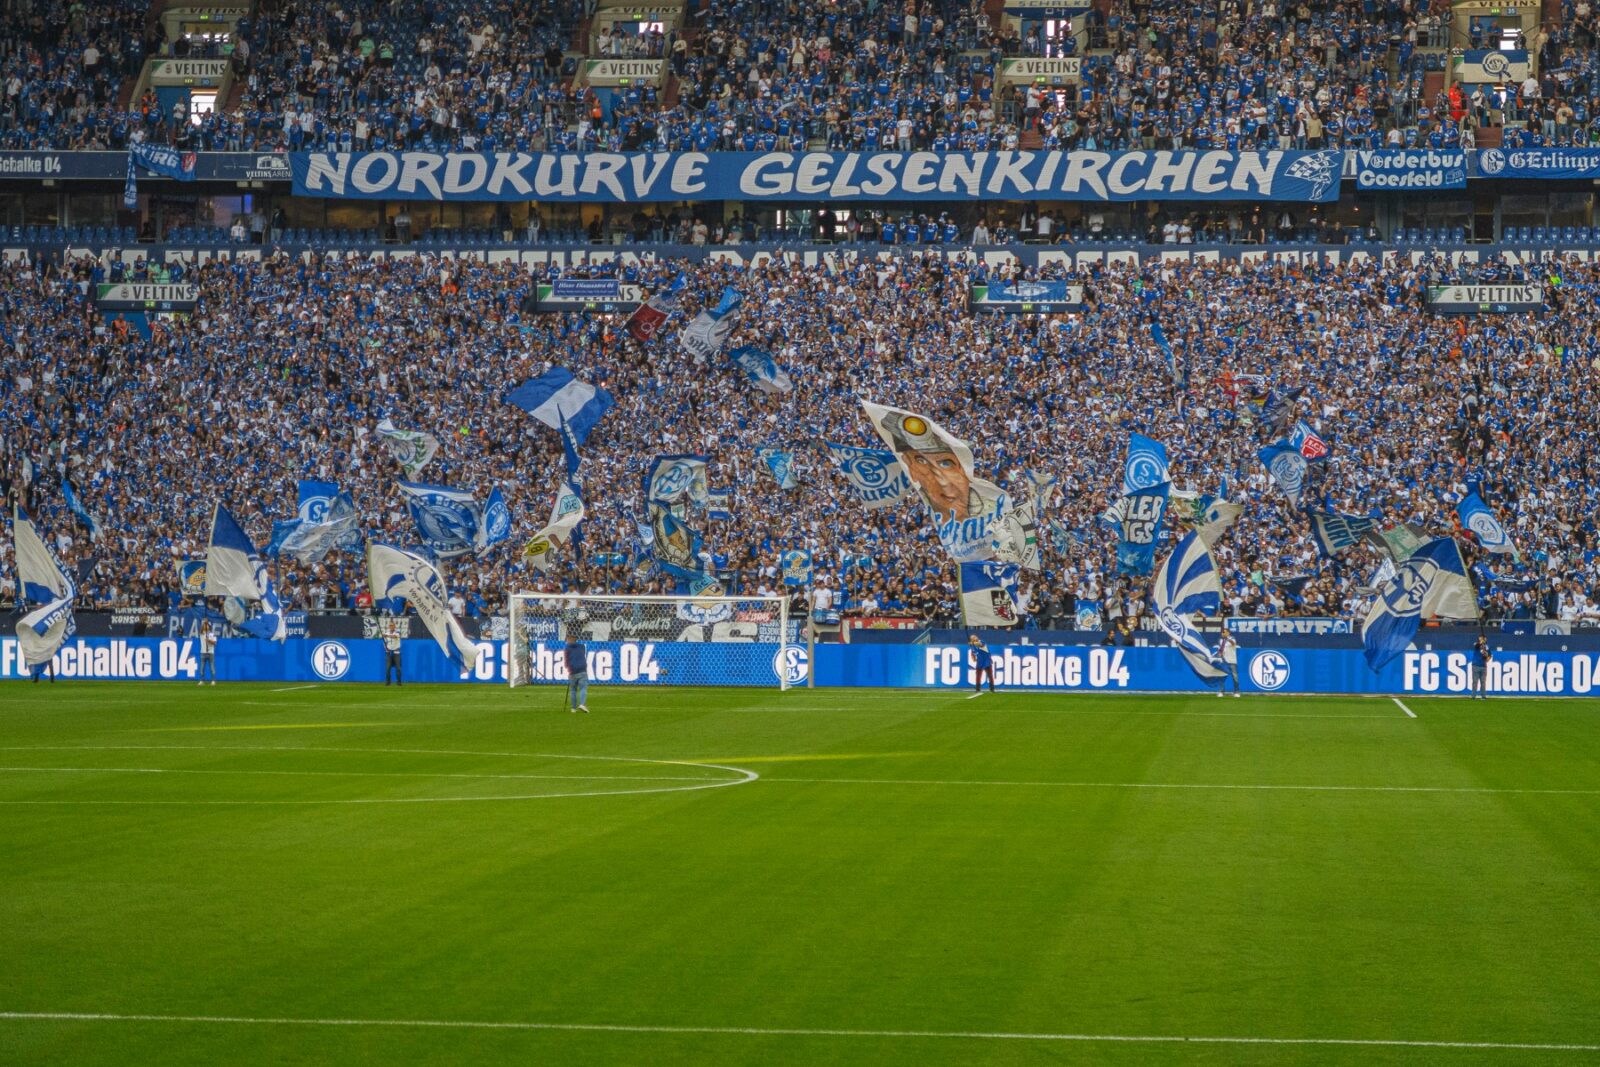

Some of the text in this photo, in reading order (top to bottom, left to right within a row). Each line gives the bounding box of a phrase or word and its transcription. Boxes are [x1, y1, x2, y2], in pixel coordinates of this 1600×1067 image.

[174, 62, 225, 76] VELTINS
[610, 62, 661, 76] VELTINS
[1026, 61, 1079, 74] VELTINS
[44, 156, 61, 173] 04
[305, 150, 1284, 202] NORDKURVE GELSENKIRCHEN
[1359, 170, 1443, 187] Coesfeld
[132, 285, 194, 301] VELTINS
[1466, 286, 1534, 302] VELTINS
[159, 640, 198, 678] 04
[620, 643, 660, 682] 04
[925, 647, 960, 685] FC
[1089, 648, 1130, 687] 04
[1404, 652, 1440, 691] FC
